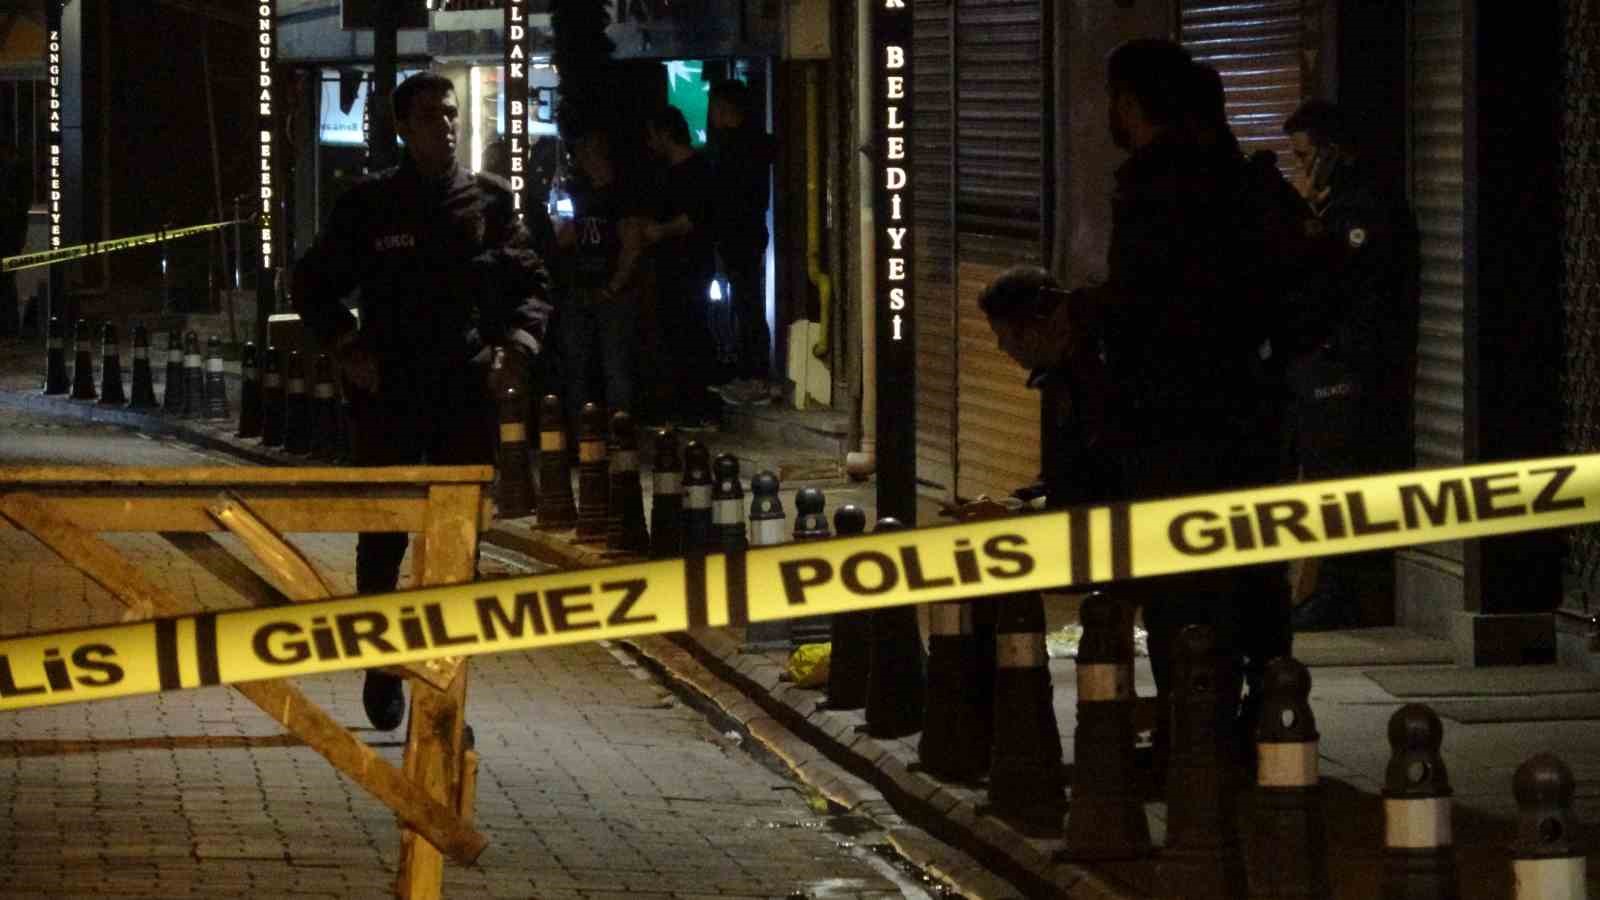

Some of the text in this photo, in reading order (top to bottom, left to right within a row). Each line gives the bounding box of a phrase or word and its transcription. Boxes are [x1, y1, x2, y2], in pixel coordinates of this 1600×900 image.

[49, 30, 60, 132] ZONGULDAK
[258, 0, 272, 115] ONGULDAK
[510, 0, 525, 79] LDAK
